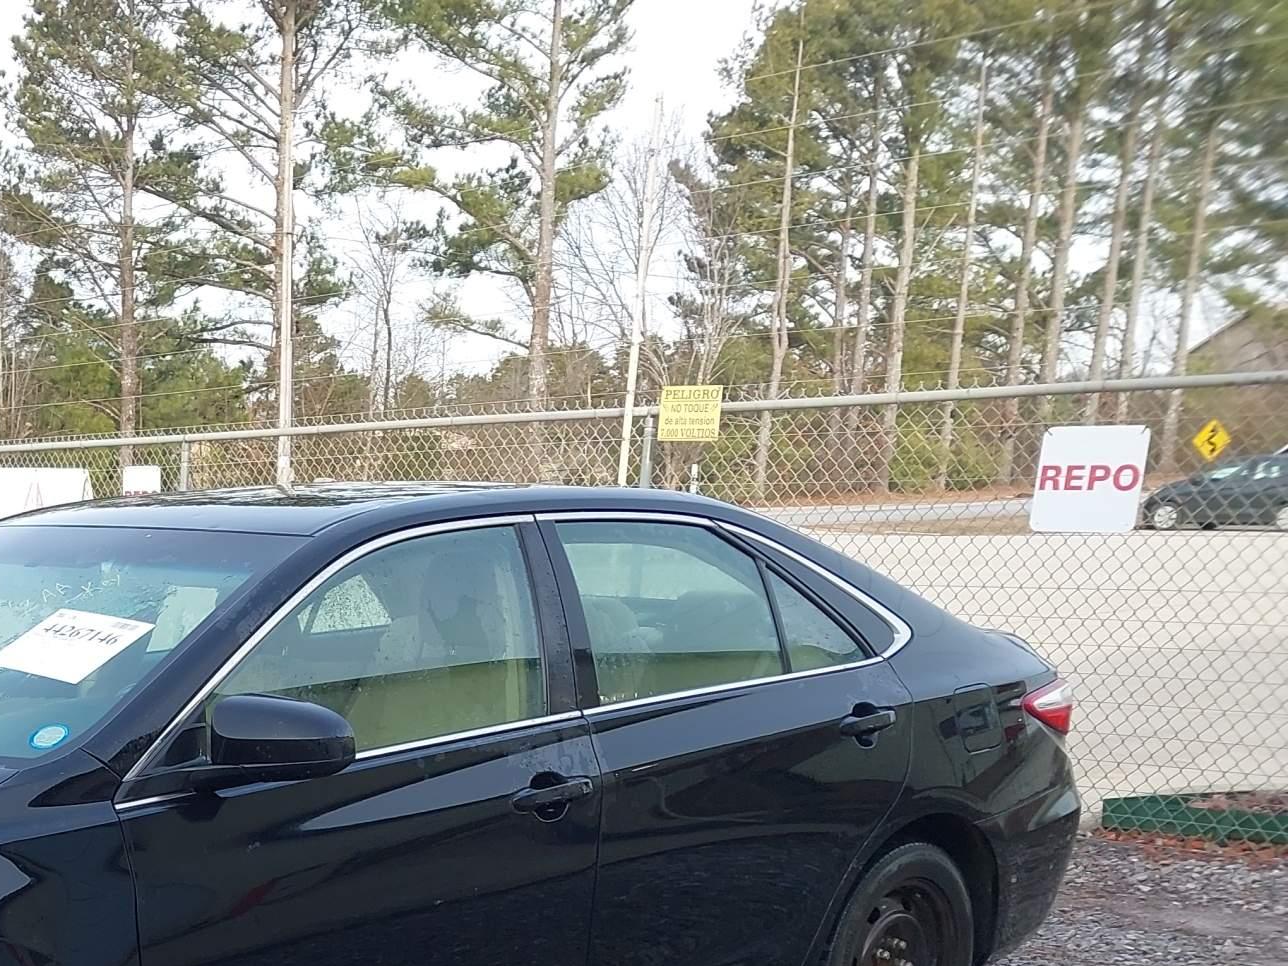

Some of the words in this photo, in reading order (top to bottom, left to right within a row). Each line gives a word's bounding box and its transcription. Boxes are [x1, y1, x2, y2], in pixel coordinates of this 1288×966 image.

[664, 389, 721, 400] PELIGRO
[671, 403, 682, 413] NO
[683, 403, 710, 413] TOQUE
[664, 416, 673, 425] de
[675, 415, 687, 425] alta
[680, 428, 716, 438] VOLTIOS
[1038, 463, 1141, 492] REPO
[42, 623, 121, 646] 44267146
